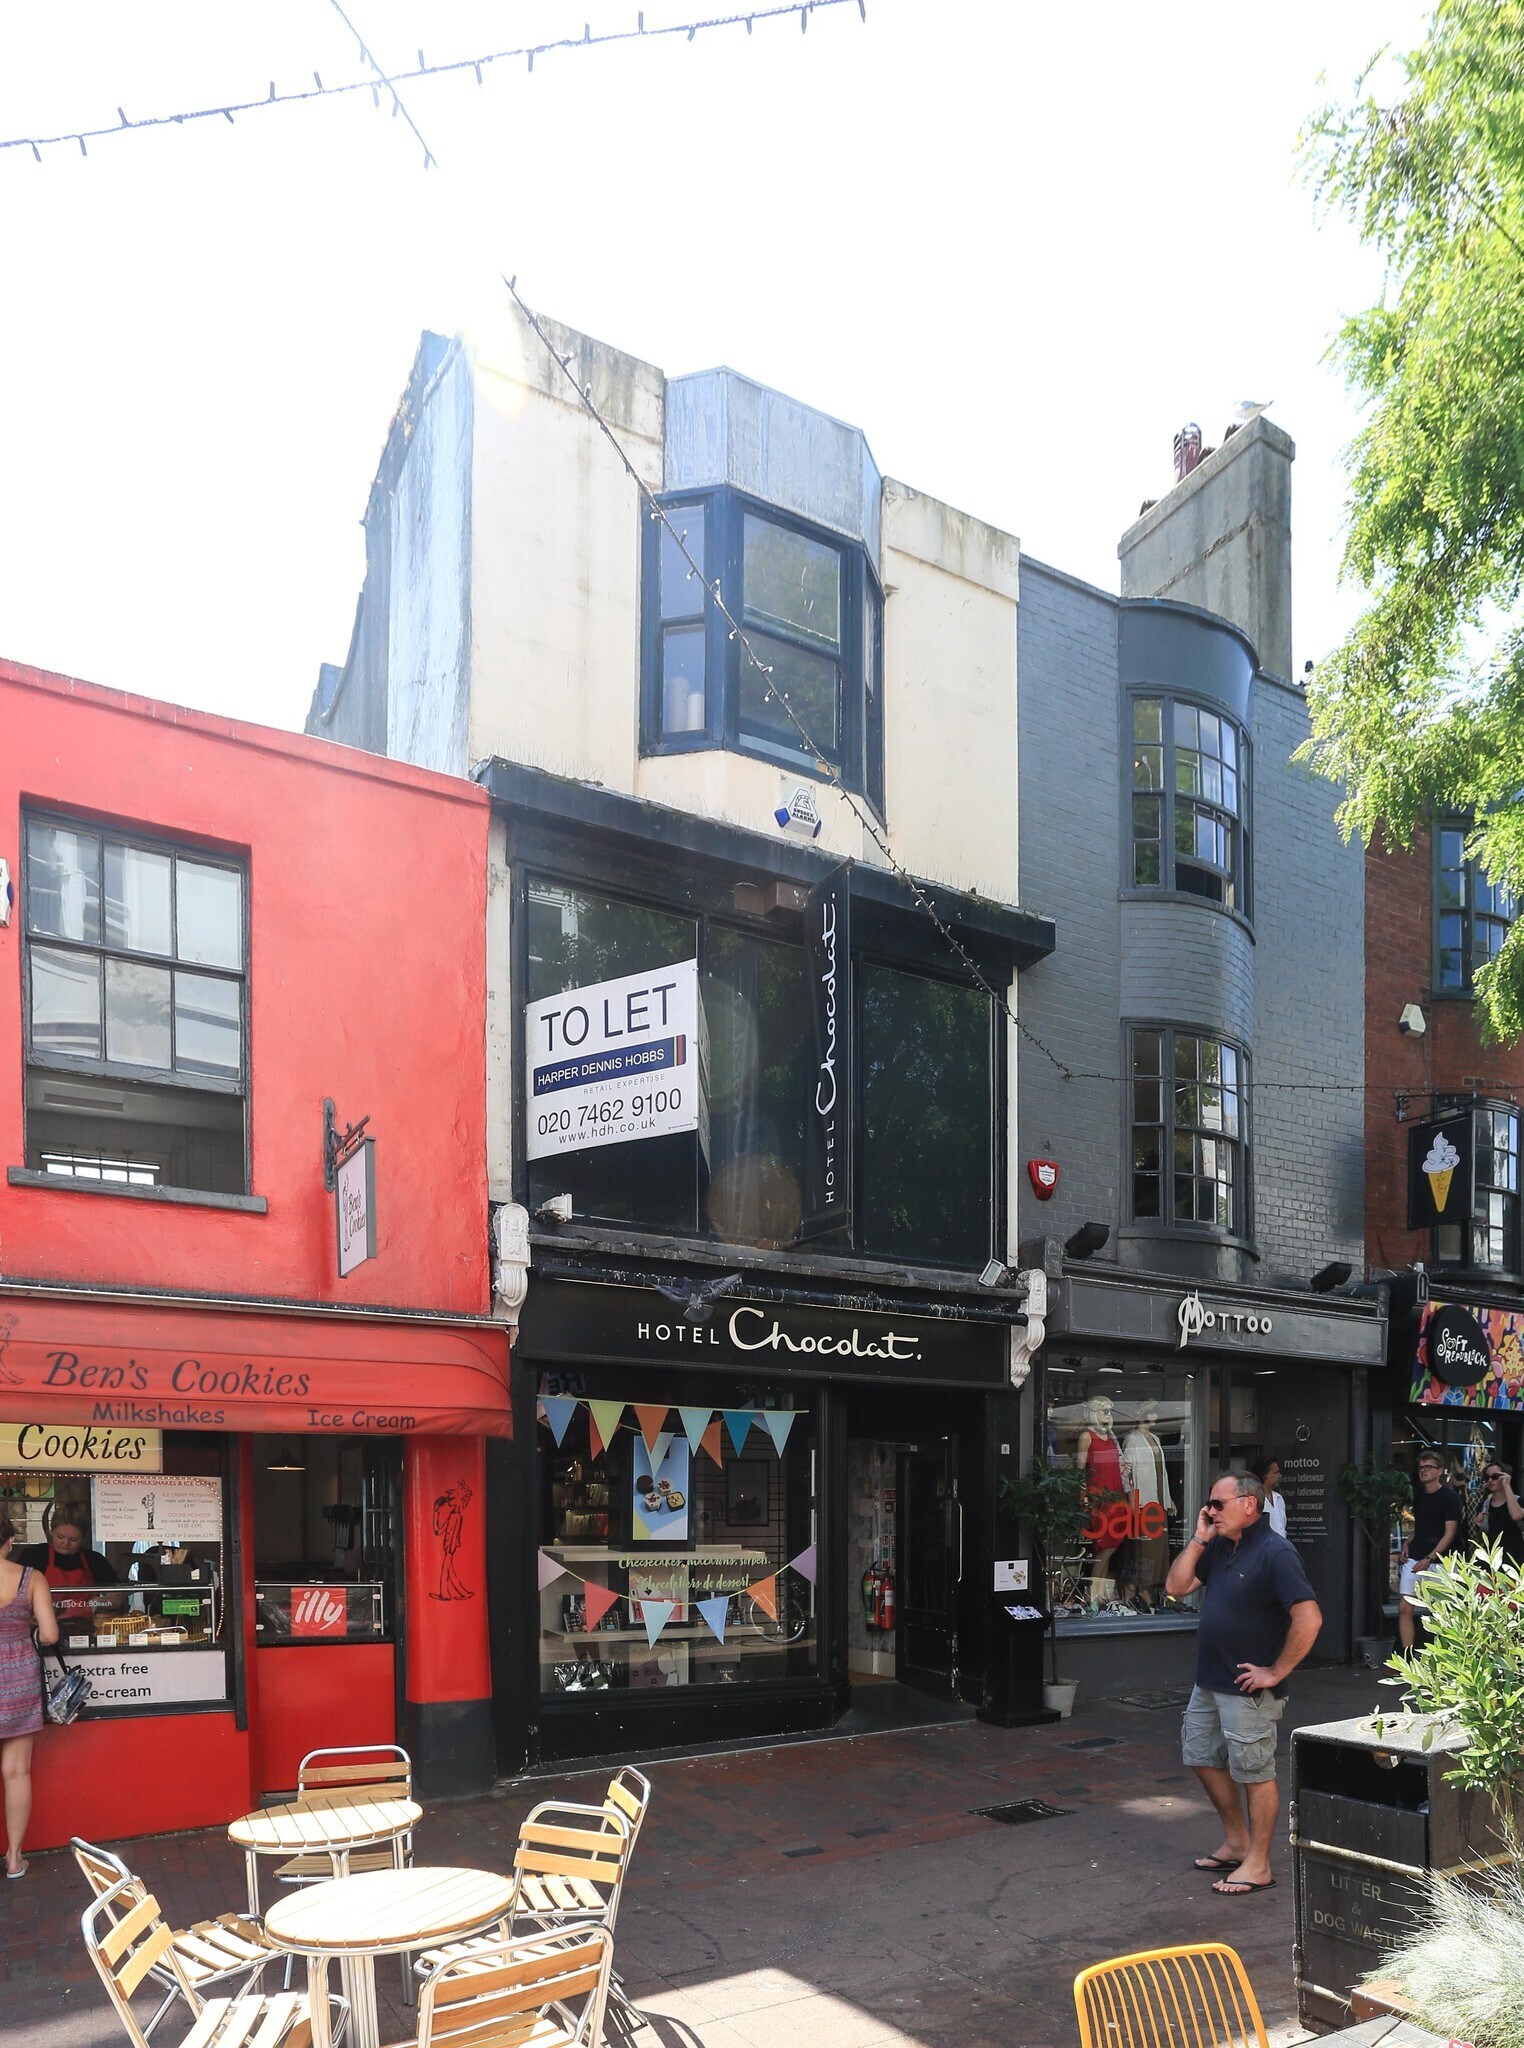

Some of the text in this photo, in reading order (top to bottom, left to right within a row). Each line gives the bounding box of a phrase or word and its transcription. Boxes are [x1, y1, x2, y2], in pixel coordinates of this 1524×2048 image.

[540, 982, 677, 1051] TO LET
[537, 1048, 665, 1086] HARPER DENNIS HOBBS
[583, 1073, 665, 1095] RETAIL EXPERTISE
[537, 1088, 682, 1136] 020 7462 9100
[558, 1117, 656, 1144] www.hdh.co.uk
[825, 1119, 835, 1203] HOTEL
[637, 1322, 720, 1345] HOTEL
[41, 1351, 310, 1396] Ben's Cookies
[92, 1402, 225, 1424] Milkshakes
[307, 1409, 416, 1429] Ice Cream
[17, 1424, 146, 1460] Cookies
[1284, 1457, 1320, 1468] mottoo
[294, 1590, 344, 1631] illy
[78, 1666, 116, 1677] extra
[121, 1663, 149, 1676] free
[1314, 1909, 1346, 1932] DOG
[1351, 1901, 1362, 1916] &
